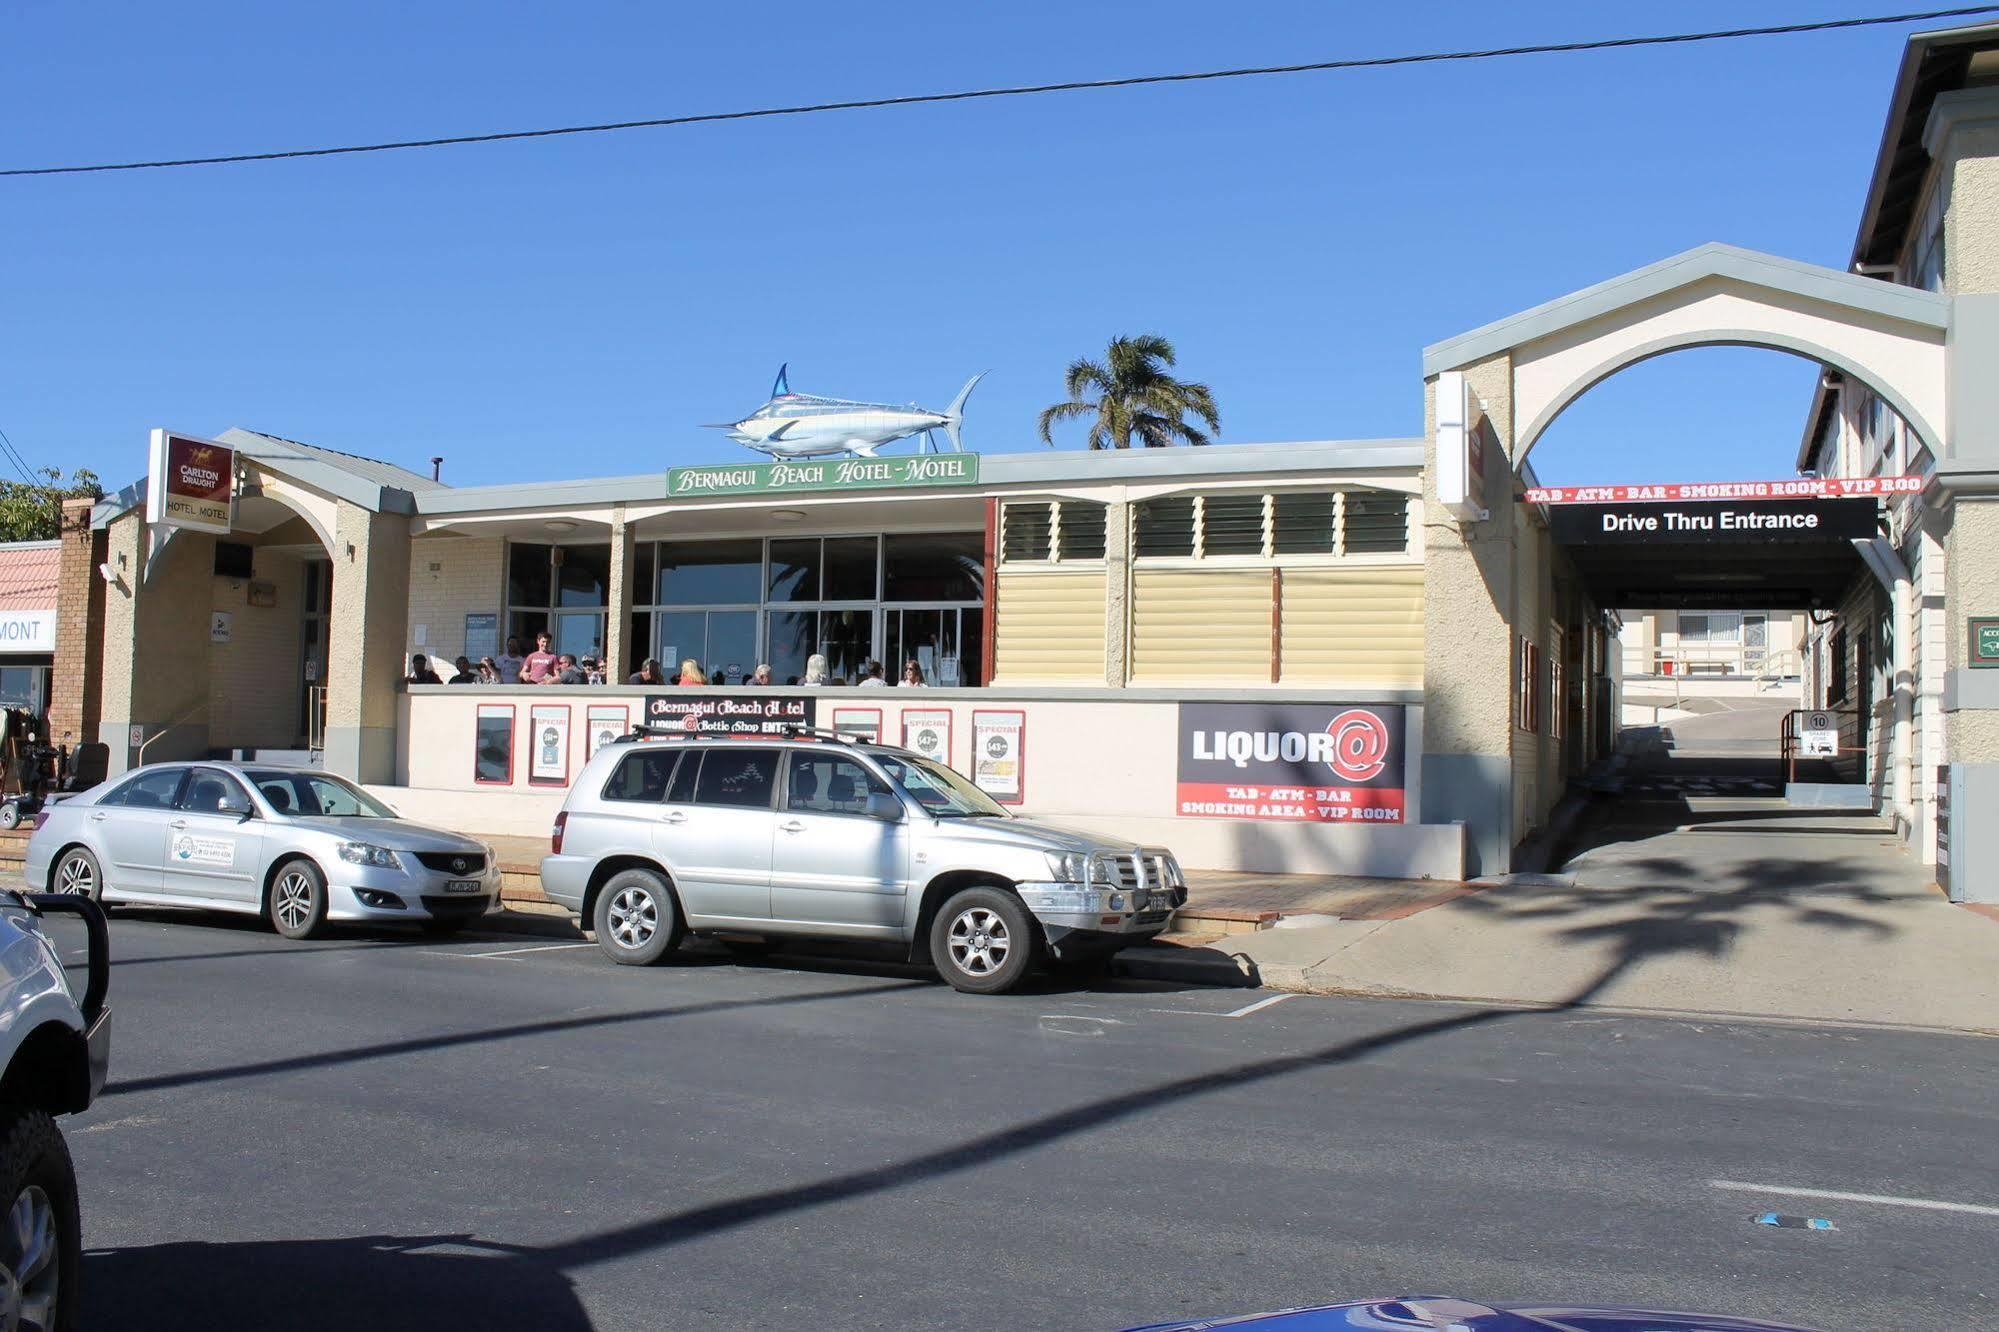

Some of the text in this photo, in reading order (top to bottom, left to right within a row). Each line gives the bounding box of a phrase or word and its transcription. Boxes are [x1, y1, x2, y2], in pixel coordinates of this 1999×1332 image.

[180, 465, 219, 481] CARLTON
[677, 470, 756, 492] BERMAGUI
[768, 465, 823, 487] BEACH
[835, 461, 892, 483] HOTEL
[904, 458, 966, 481] MOTEL
[182, 476, 216, 489] DRAUGHT
[1527, 489, 1563, 502] TAB
[1575, 488, 1614, 501] ATM
[1627, 487, 1667, 499] BAR
[1680, 484, 1767, 498] SMOKING
[1771, 482, 1827, 495] ROOM
[1840, 480, 1876, 493] VIP
[168, 501, 228, 520] HOTEL MOTEL
[1603, 512, 1818, 531] Drive Thru Entrance
[651, 699, 715, 718] Bermagui
[718, 700, 762, 715] Beach
[698, 720, 730, 732] Bottle
[731, 721, 759, 732] Shop
[1813, 717, 1826, 727] 10
[1227, 787, 1258, 799] TAB
[1269, 788, 1305, 800] ATM
[1316, 790, 1352, 802] BAR
[1182, 802, 1256, 815] SMOKING
[1259, 804, 1306, 817] AREA
[1318, 805, 1348, 818] VIP
[1352, 807, 1399, 820] ROOM
